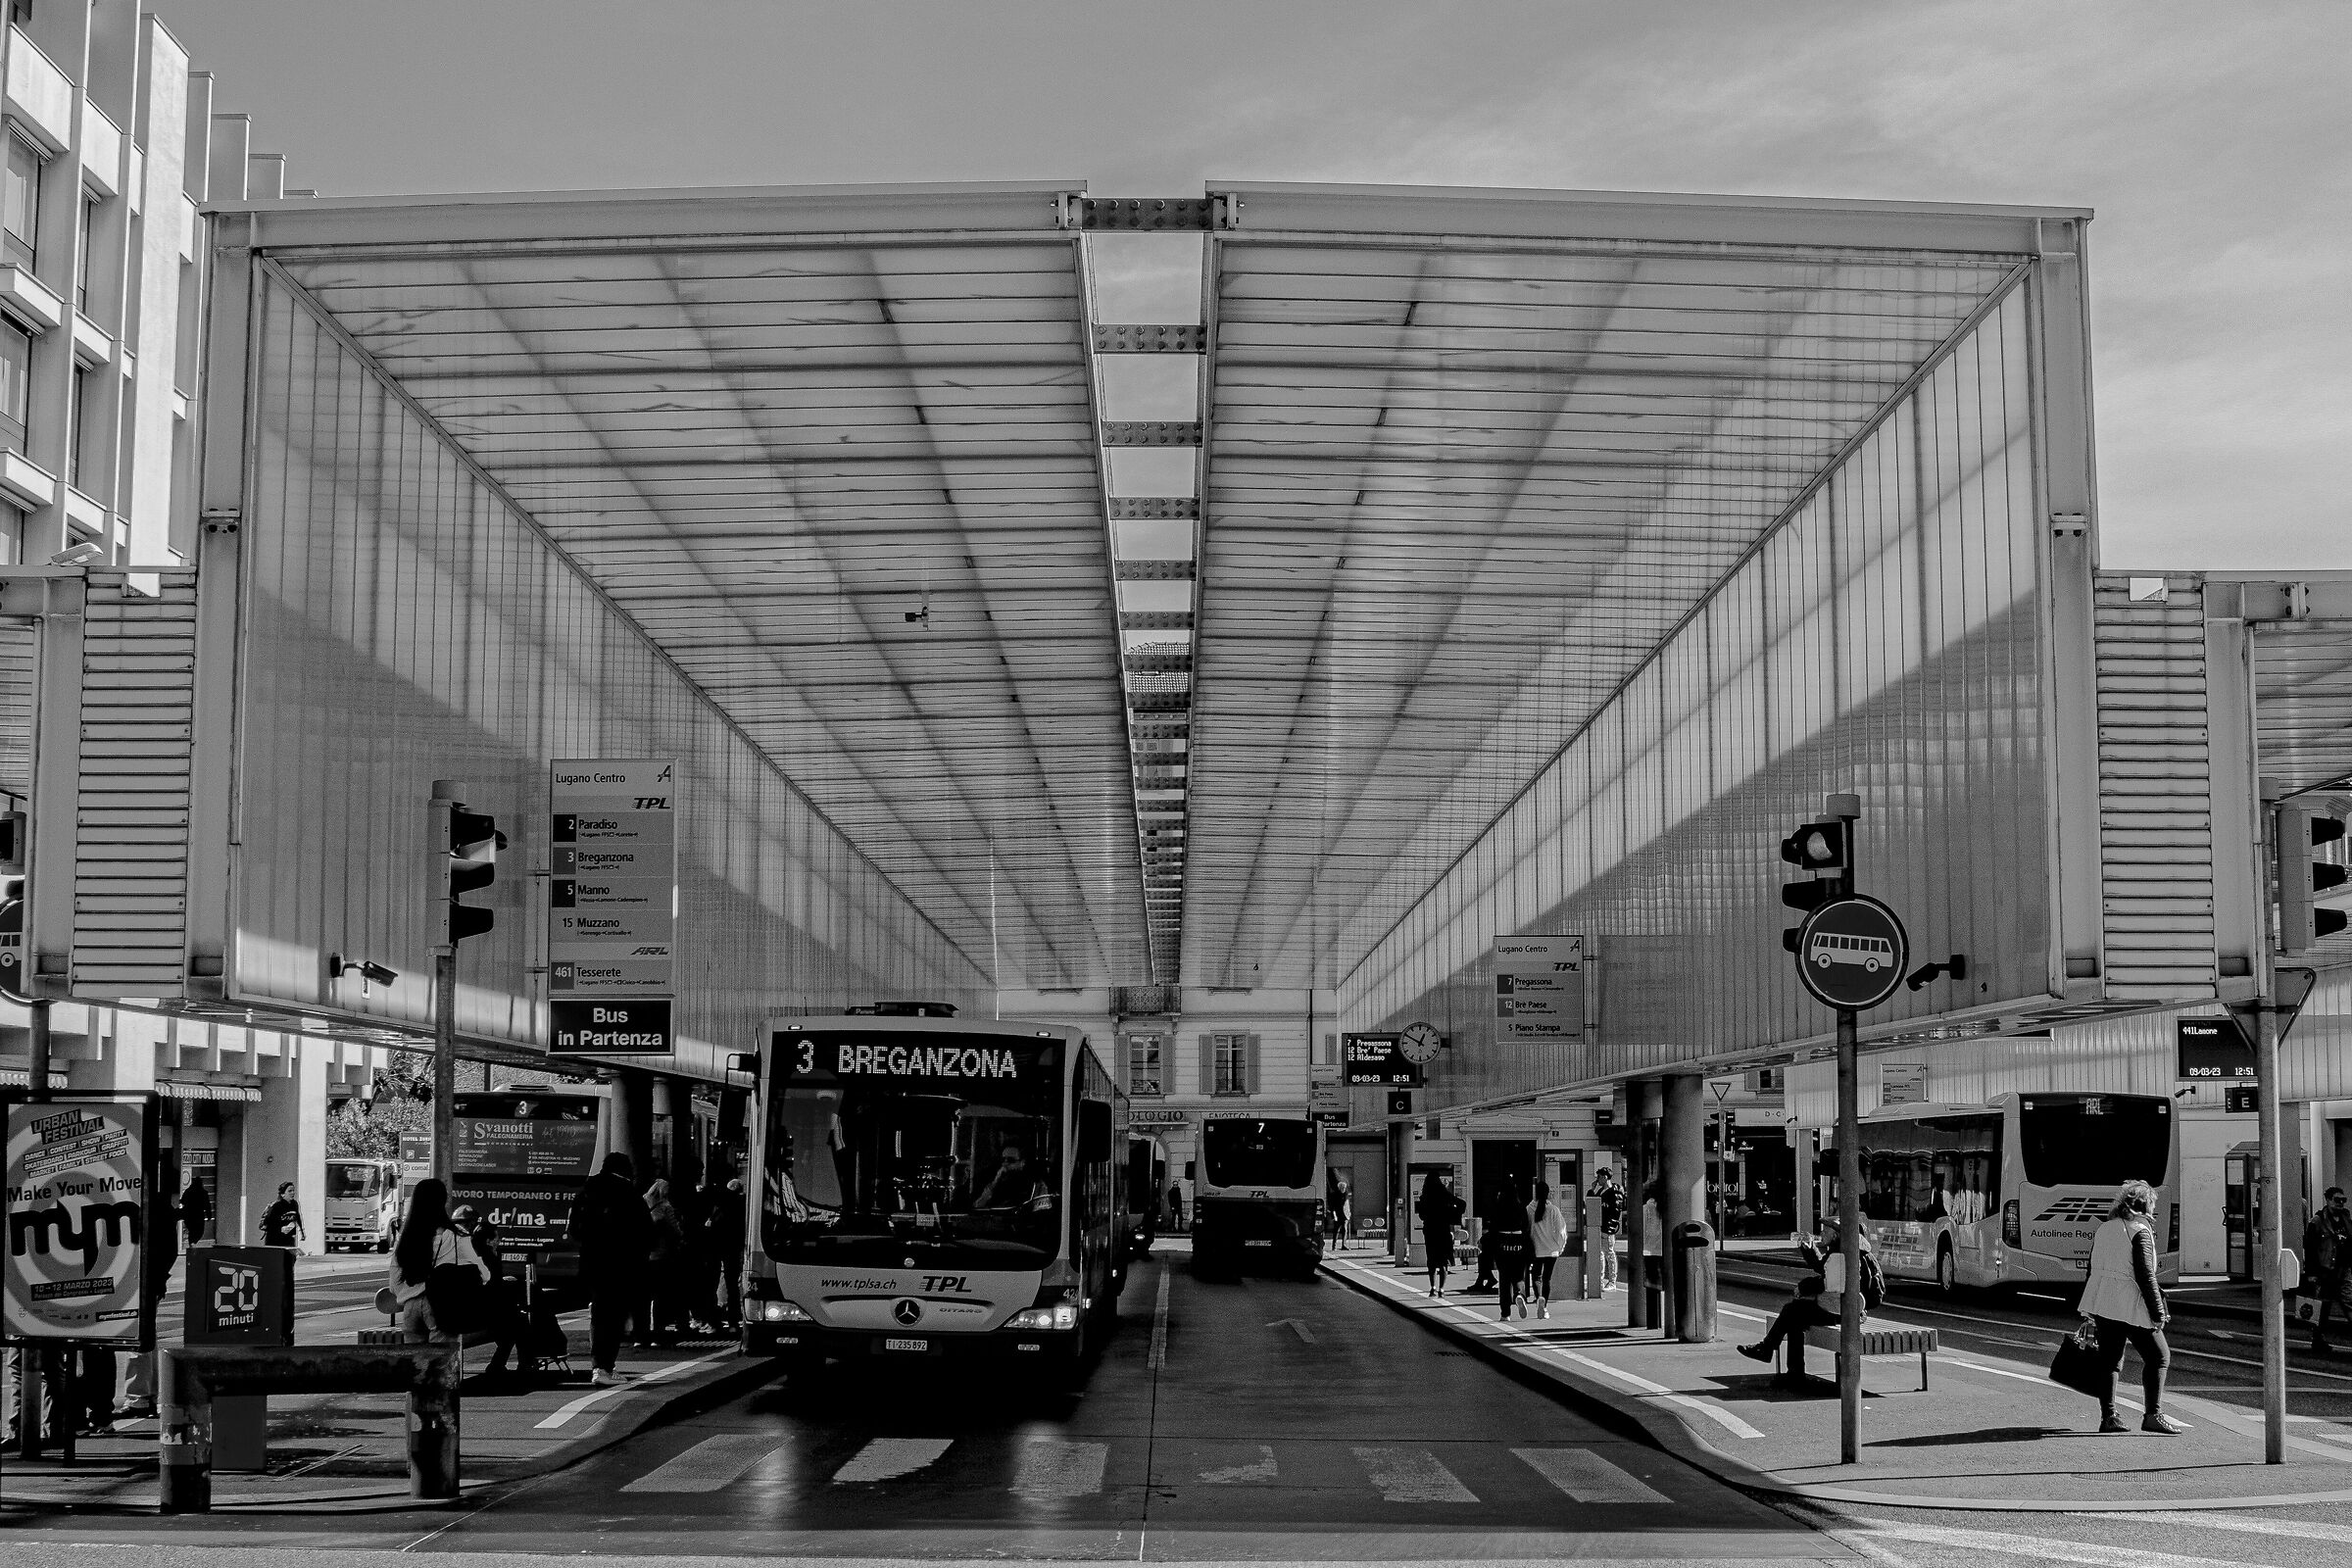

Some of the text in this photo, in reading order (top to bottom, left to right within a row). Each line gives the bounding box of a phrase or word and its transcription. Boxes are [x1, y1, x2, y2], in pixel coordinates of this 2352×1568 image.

[556, 773, 625, 785] Lugano Centro
[632, 798, 671, 809] TPL
[568, 818, 618, 830] 2 Paradiso
[568, 852, 634, 864] 3 Breganzona
[567, 885, 611, 895] 5 Manno
[563, 918, 620, 928] 15 Muzzano
[1497, 946, 1523, 955] Lugano
[556, 966, 621, 977] 461 Tesserete
[1553, 962, 1580, 971] TPL
[1515, 978, 1552, 987] Pregassona
[593, 1007, 628, 1023] Bus
[1535, 1024, 1561, 1033] Stampa
[558, 1030, 662, 1046] in Partenza
[797, 1040, 1017, 1078] 3 BREGANZONA
[2235, 1067, 2254, 1076] 12:51
[519, 1101, 527, 1114] 3
[1396, 1101, 1404, 1110] C
[2241, 1098, 2250, 1108] E
[33, 1110, 78, 1133] URBAN
[45, 1117, 104, 1143] FESTIVAL
[474, 1122, 533, 1139] Svanotti
[1257, 1122, 1265, 1134] 7
[24, 1131, 125, 1160] DANCE CONTEST SHOW PARTY
[24, 1139, 128, 1170] SKATEBOARD PARKOUR GRAFFITI
[29, 1149, 125, 1178] MARKET FAMILY STREET FOOD
[7, 1177, 141, 1202] Make Your Move
[487, 1191, 552, 1200] TEMPORANEO
[64, 1281, 91, 1291] MARZO
[92, 1278, 113, 1288] 2023
[215, 1266, 259, 1312] 20
[821, 1276, 972, 1293] www.tplsa.ch TPL
[219, 1313, 254, 1326] minuti
[887, 1340, 896, 1348] TI
